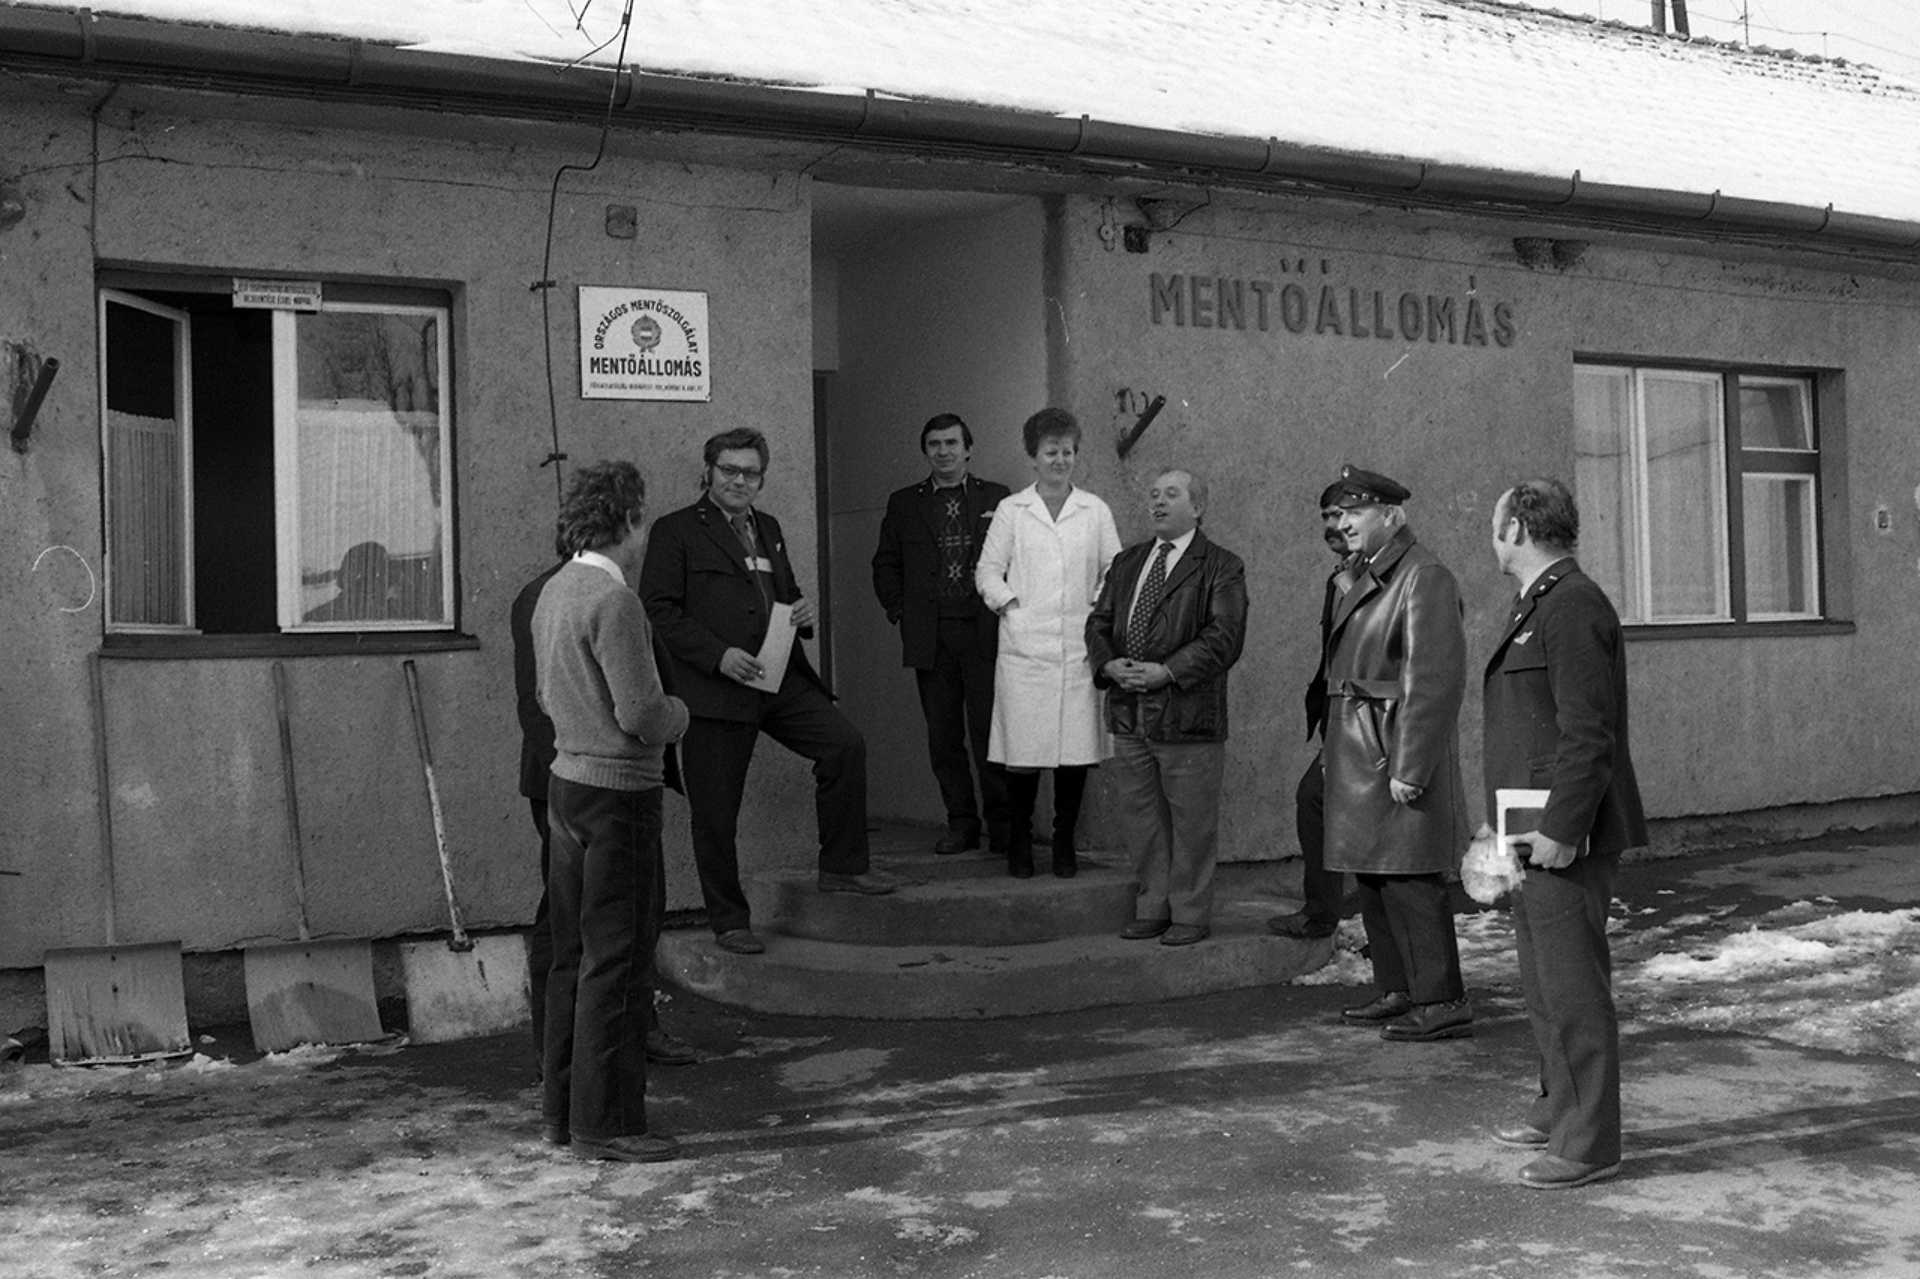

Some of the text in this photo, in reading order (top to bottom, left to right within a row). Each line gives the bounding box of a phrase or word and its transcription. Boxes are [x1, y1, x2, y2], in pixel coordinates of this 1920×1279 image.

[594, 298, 699, 355] ORSZÁGOS MENTŐSZOLGÁLAT
[1149, 257, 1517, 348] MENTŐÁLLOMÁS
[590, 354, 702, 378] MENTŐÁLLOMÁS
